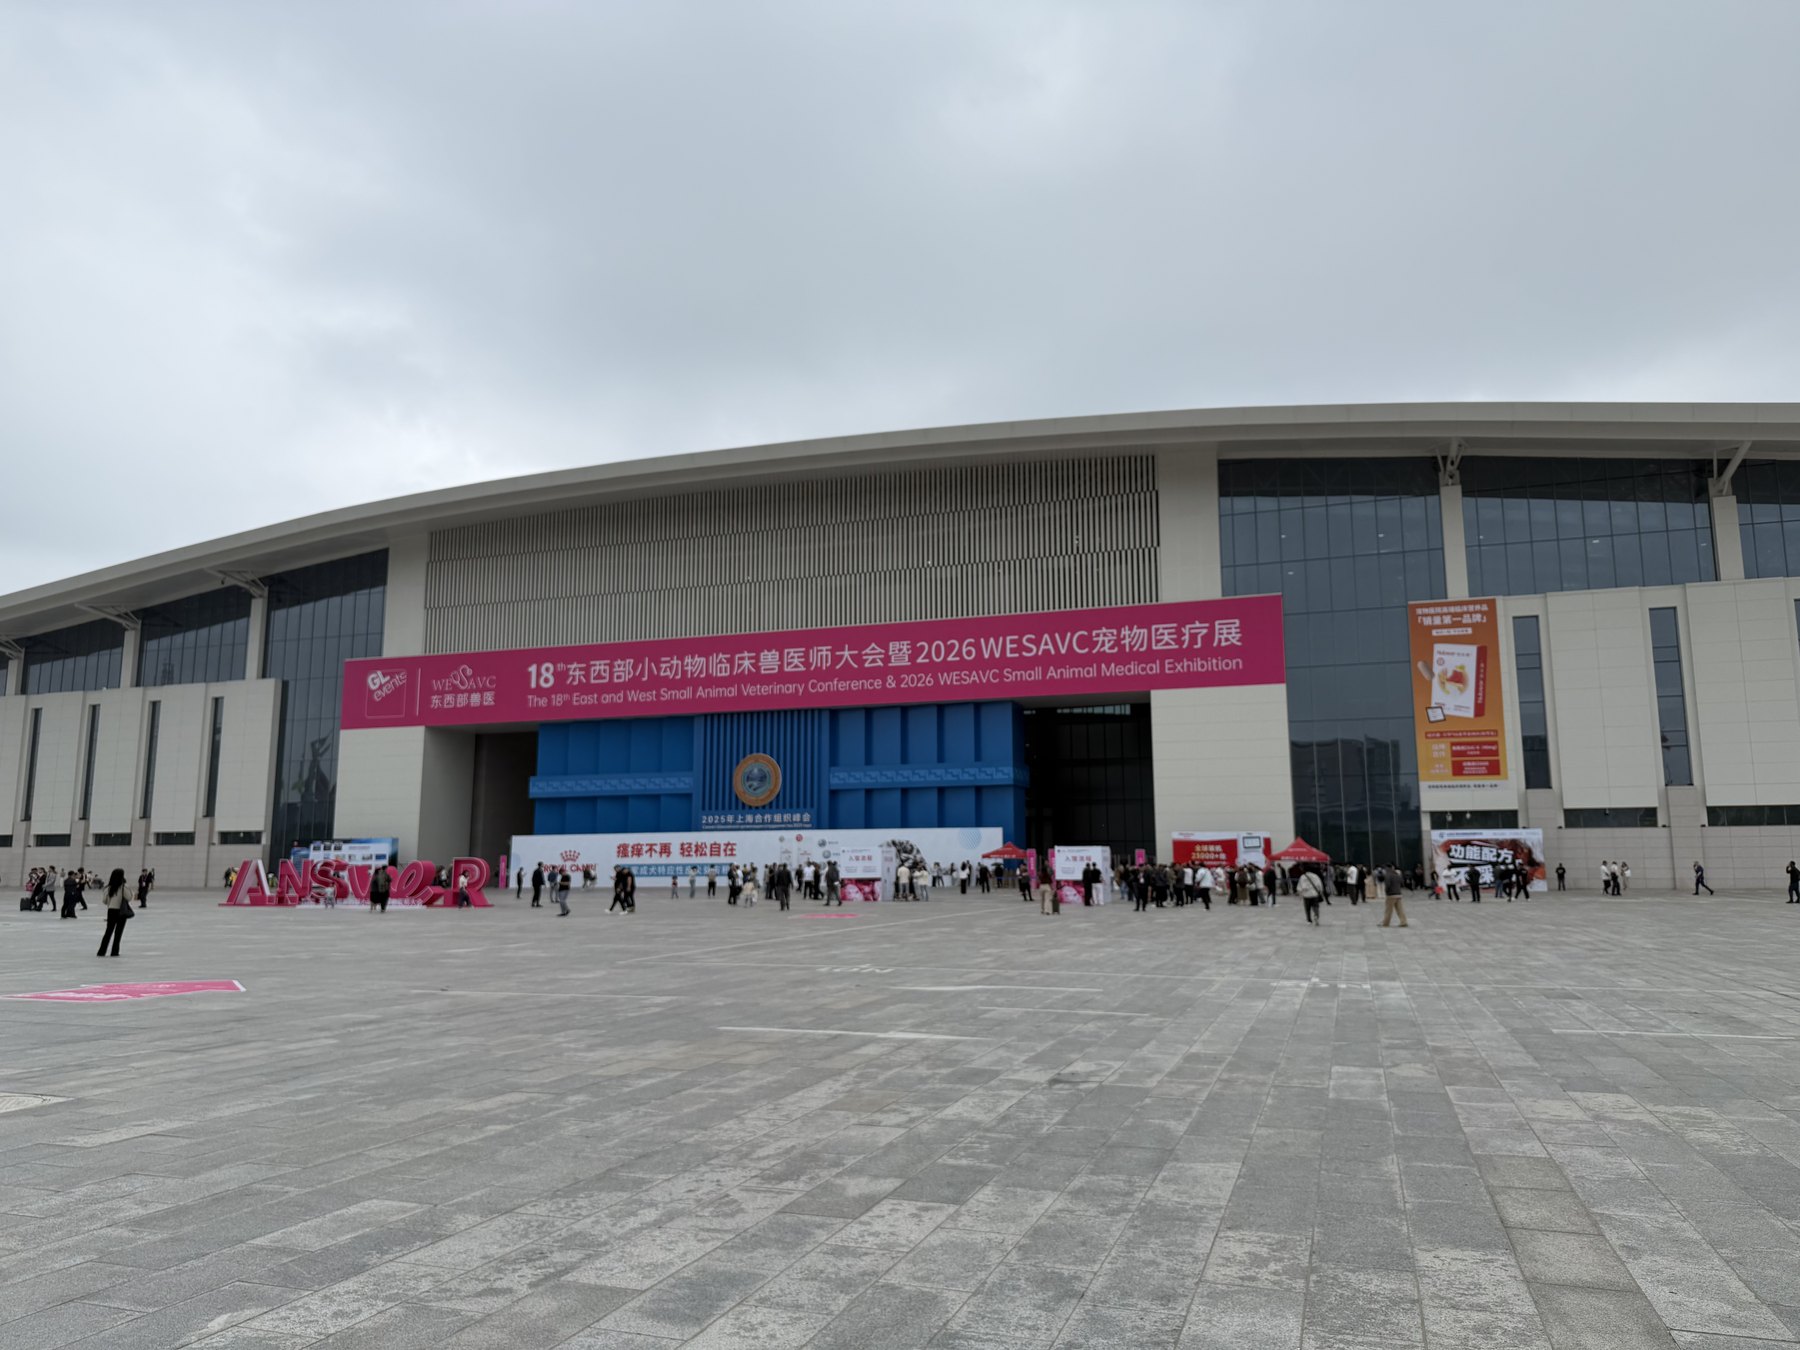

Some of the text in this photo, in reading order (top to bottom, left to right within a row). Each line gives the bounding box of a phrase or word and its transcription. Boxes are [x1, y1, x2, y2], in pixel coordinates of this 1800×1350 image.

[367, 670, 391, 690] GL
[373, 671, 408, 702] events
[528, 656, 1243, 708] The 18th East and West Small Animal Veterinary Conference & 2026 WESAVC Small Animal Medical Exhibition
[430, 691, 496, 709] 东西部兽医
[702, 812, 811, 824] 2025年上海合作组织峰会
[679, 841, 737, 857] 轻松自在
[1449, 844, 1514, 863] 功能配方
